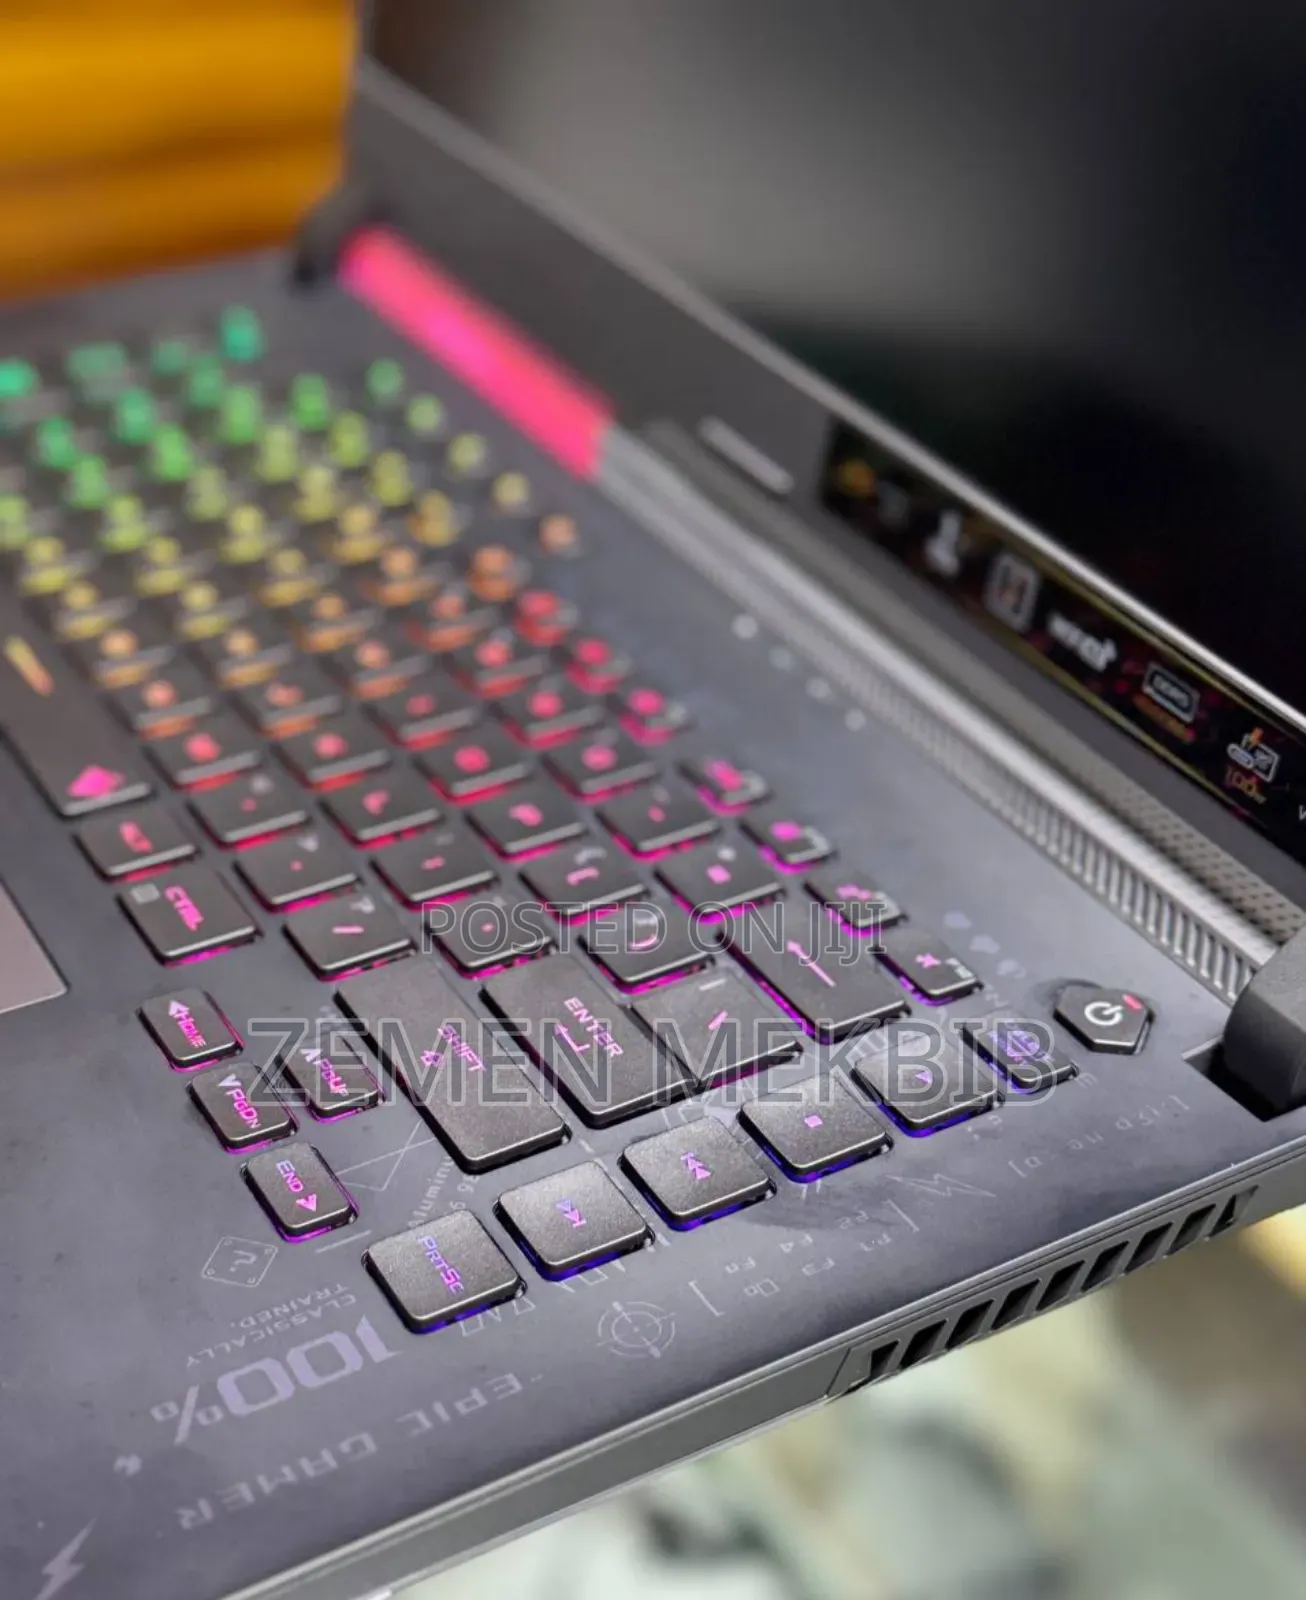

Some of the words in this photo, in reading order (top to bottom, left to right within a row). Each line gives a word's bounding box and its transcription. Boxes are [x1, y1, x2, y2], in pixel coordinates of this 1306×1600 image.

[437, 1023, 486, 1074] SHIFT
[563, 996, 625, 1060] ENTER
[186, 1294, 358, 1368] CLASSICALLY
[150, 1315, 400, 1446] 100%
[175, 1432, 378, 1531] GAMER
